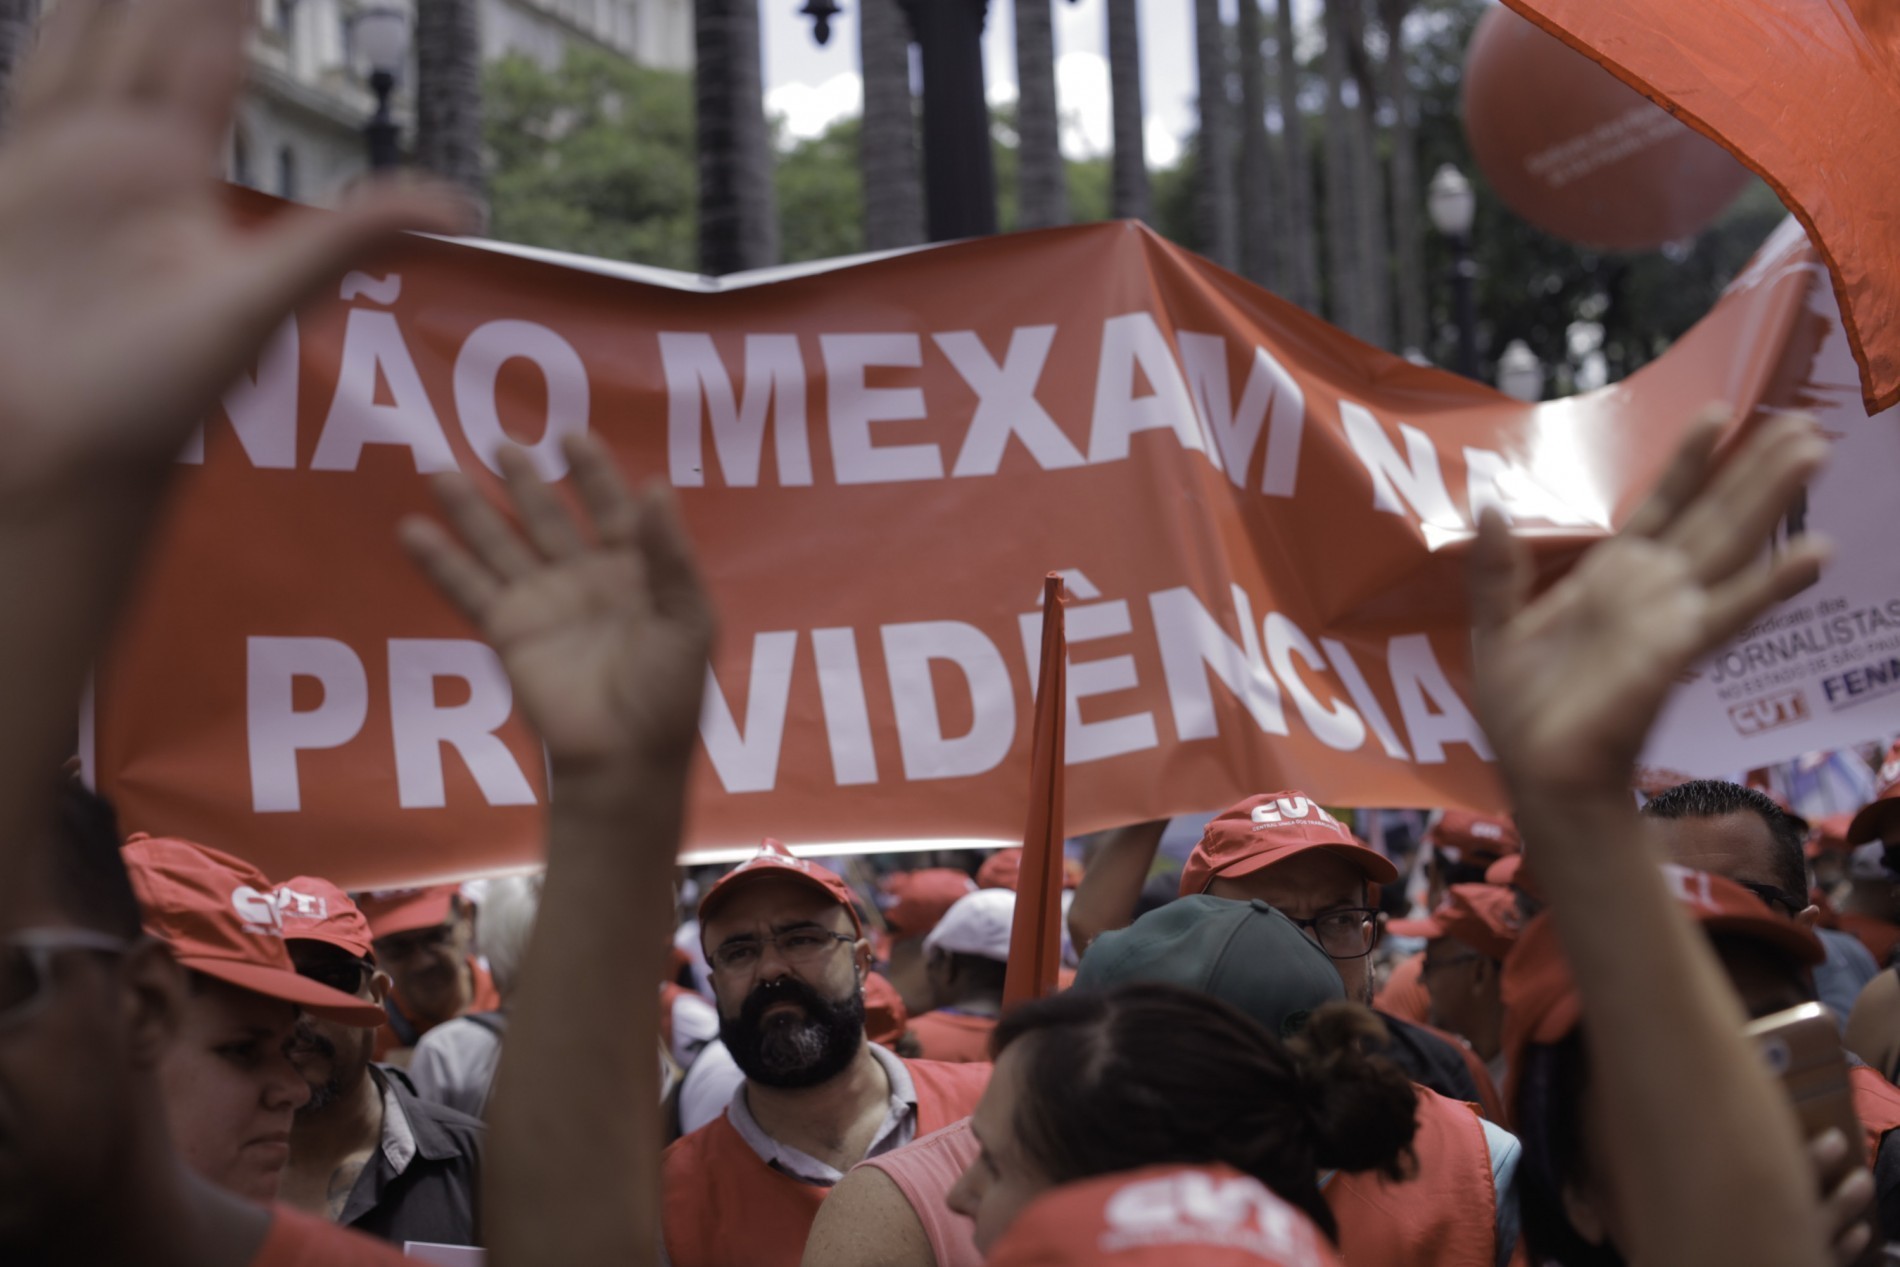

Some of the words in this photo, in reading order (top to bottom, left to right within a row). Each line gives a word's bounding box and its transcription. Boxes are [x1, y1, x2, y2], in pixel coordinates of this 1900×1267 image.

[174, 270, 590, 484] NÃO
[657, 311, 1306, 499] MEXAM
[1816, 596, 1850, 618] dos
[1711, 599, 1900, 684] JORNALISTAS
[246, 567, 1500, 814] PRVIDÊNCIA
[1743, 662, 1807, 693] ESTADO
[1808, 655, 1829, 676] DE
[1731, 690, 1808, 736] CUT
[1252, 822, 1278, 832] CENTRAL
